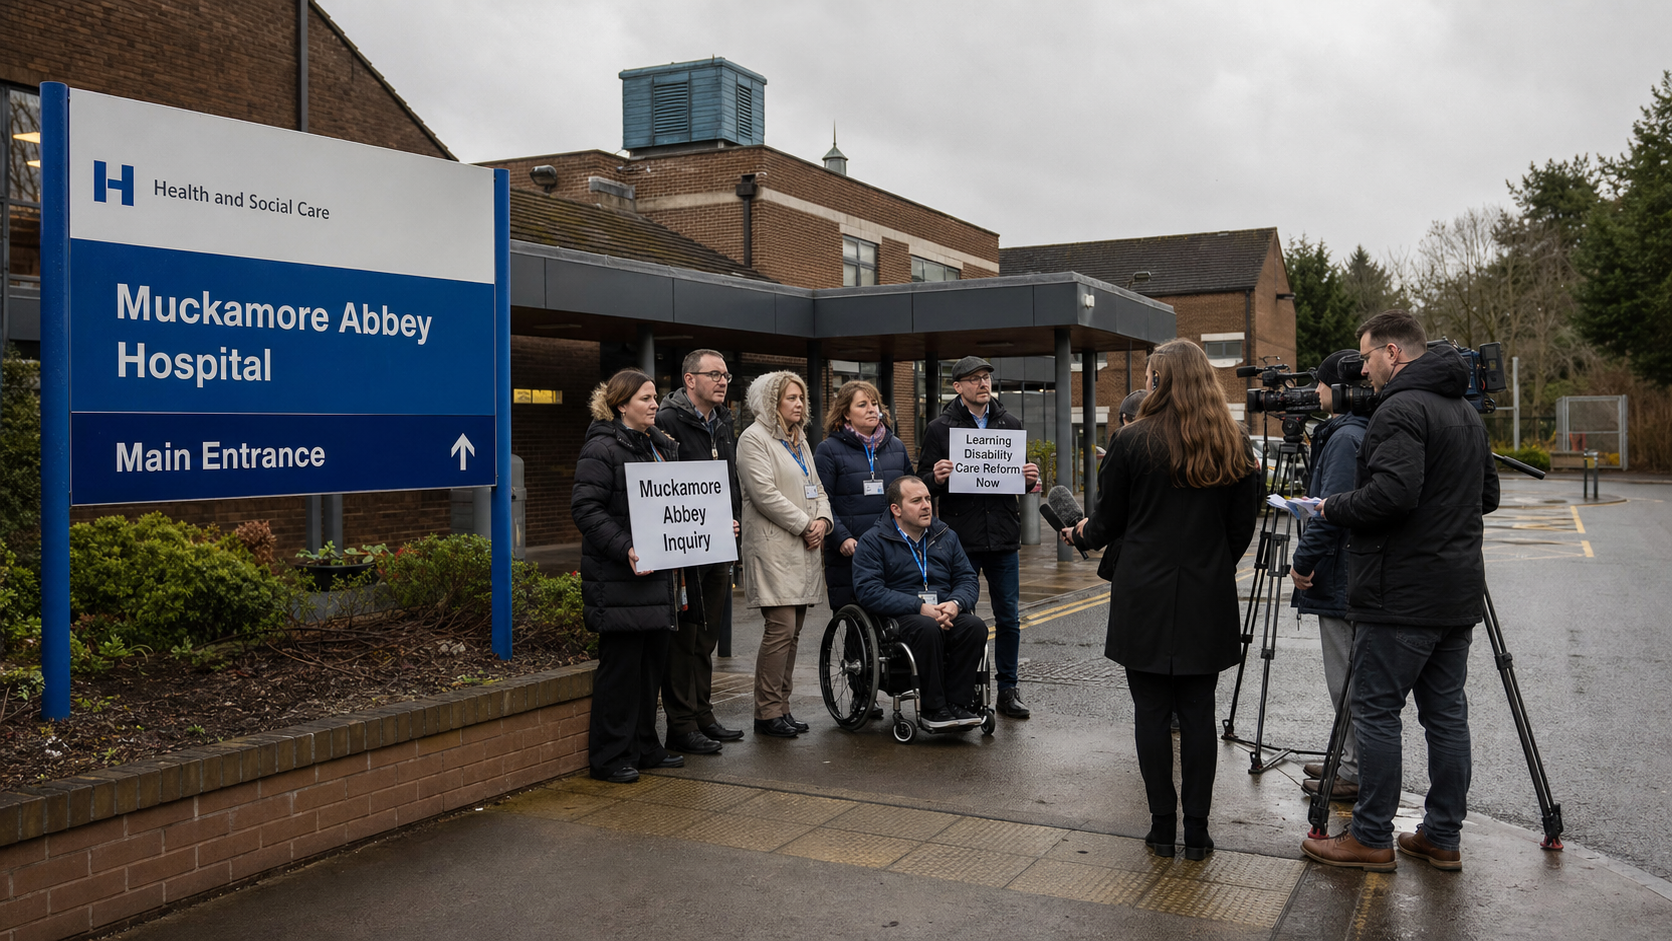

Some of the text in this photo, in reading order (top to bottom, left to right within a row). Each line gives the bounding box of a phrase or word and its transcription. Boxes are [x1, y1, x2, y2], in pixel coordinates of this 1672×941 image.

[154, 179, 330, 220] Health and Social Care
[117, 283, 433, 346] Muckamore Abbey
[117, 342, 271, 388] Hospital
[966, 434, 1012, 448] Learning
[116, 441, 326, 473] Main Entrance
[964, 449, 1013, 462] Disability
[955, 462, 1021, 475] Care Reform
[639, 478, 722, 498] Muckamore
[976, 477, 1001, 488] Now
[663, 504, 706, 526] Abbey
[663, 530, 711, 555] Inquiry
